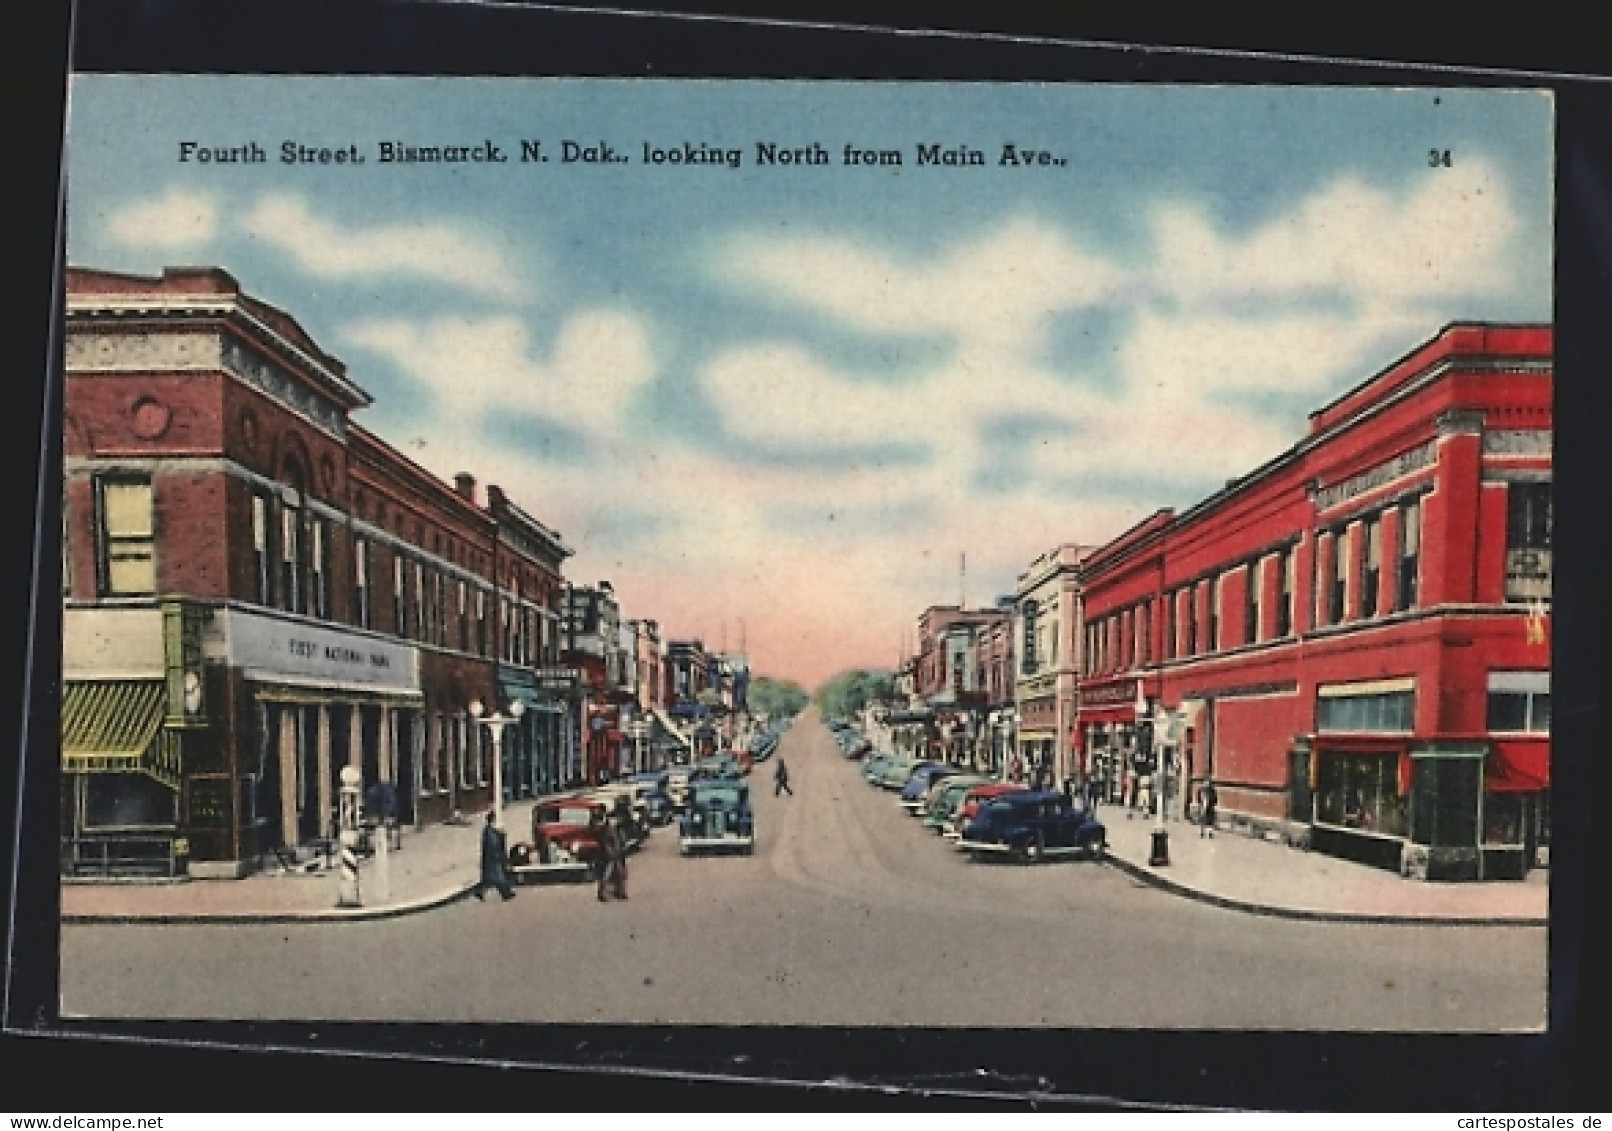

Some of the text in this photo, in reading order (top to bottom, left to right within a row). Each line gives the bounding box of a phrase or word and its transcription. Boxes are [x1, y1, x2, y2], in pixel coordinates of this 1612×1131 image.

[178, 141, 267, 164] Fourth
[520, 140, 549, 163] N.
[643, 142, 742, 169] looking
[756, 143, 829, 166] North
[843, 143, 903, 166] from
[916, 143, 986, 167] Main
[1428, 148, 1453, 168] 34
